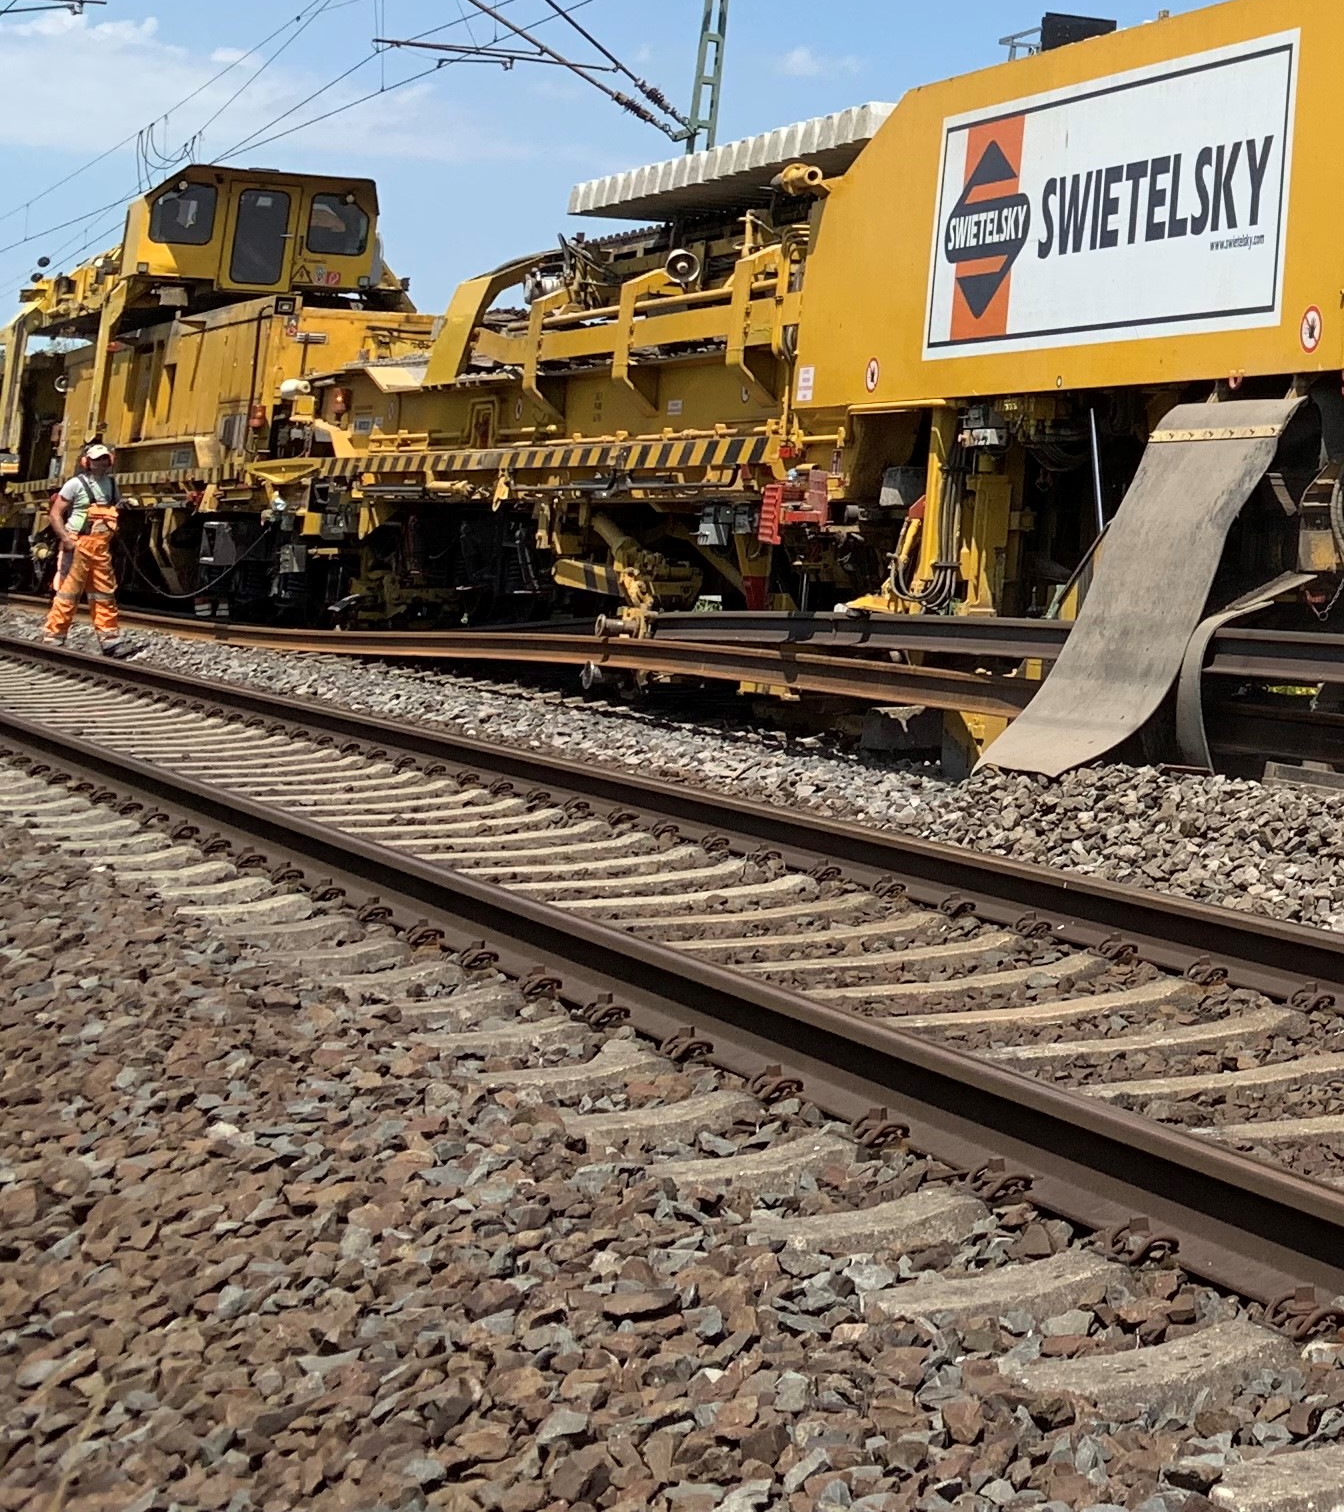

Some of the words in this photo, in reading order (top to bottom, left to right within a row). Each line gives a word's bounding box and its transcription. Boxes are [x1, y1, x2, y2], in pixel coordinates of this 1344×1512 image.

[1038, 134, 1274, 259] SWIETELSKY
[947, 203, 1028, 251] SWIETELSKY
[1209, 233, 1265, 251] www.swietelsky.com
